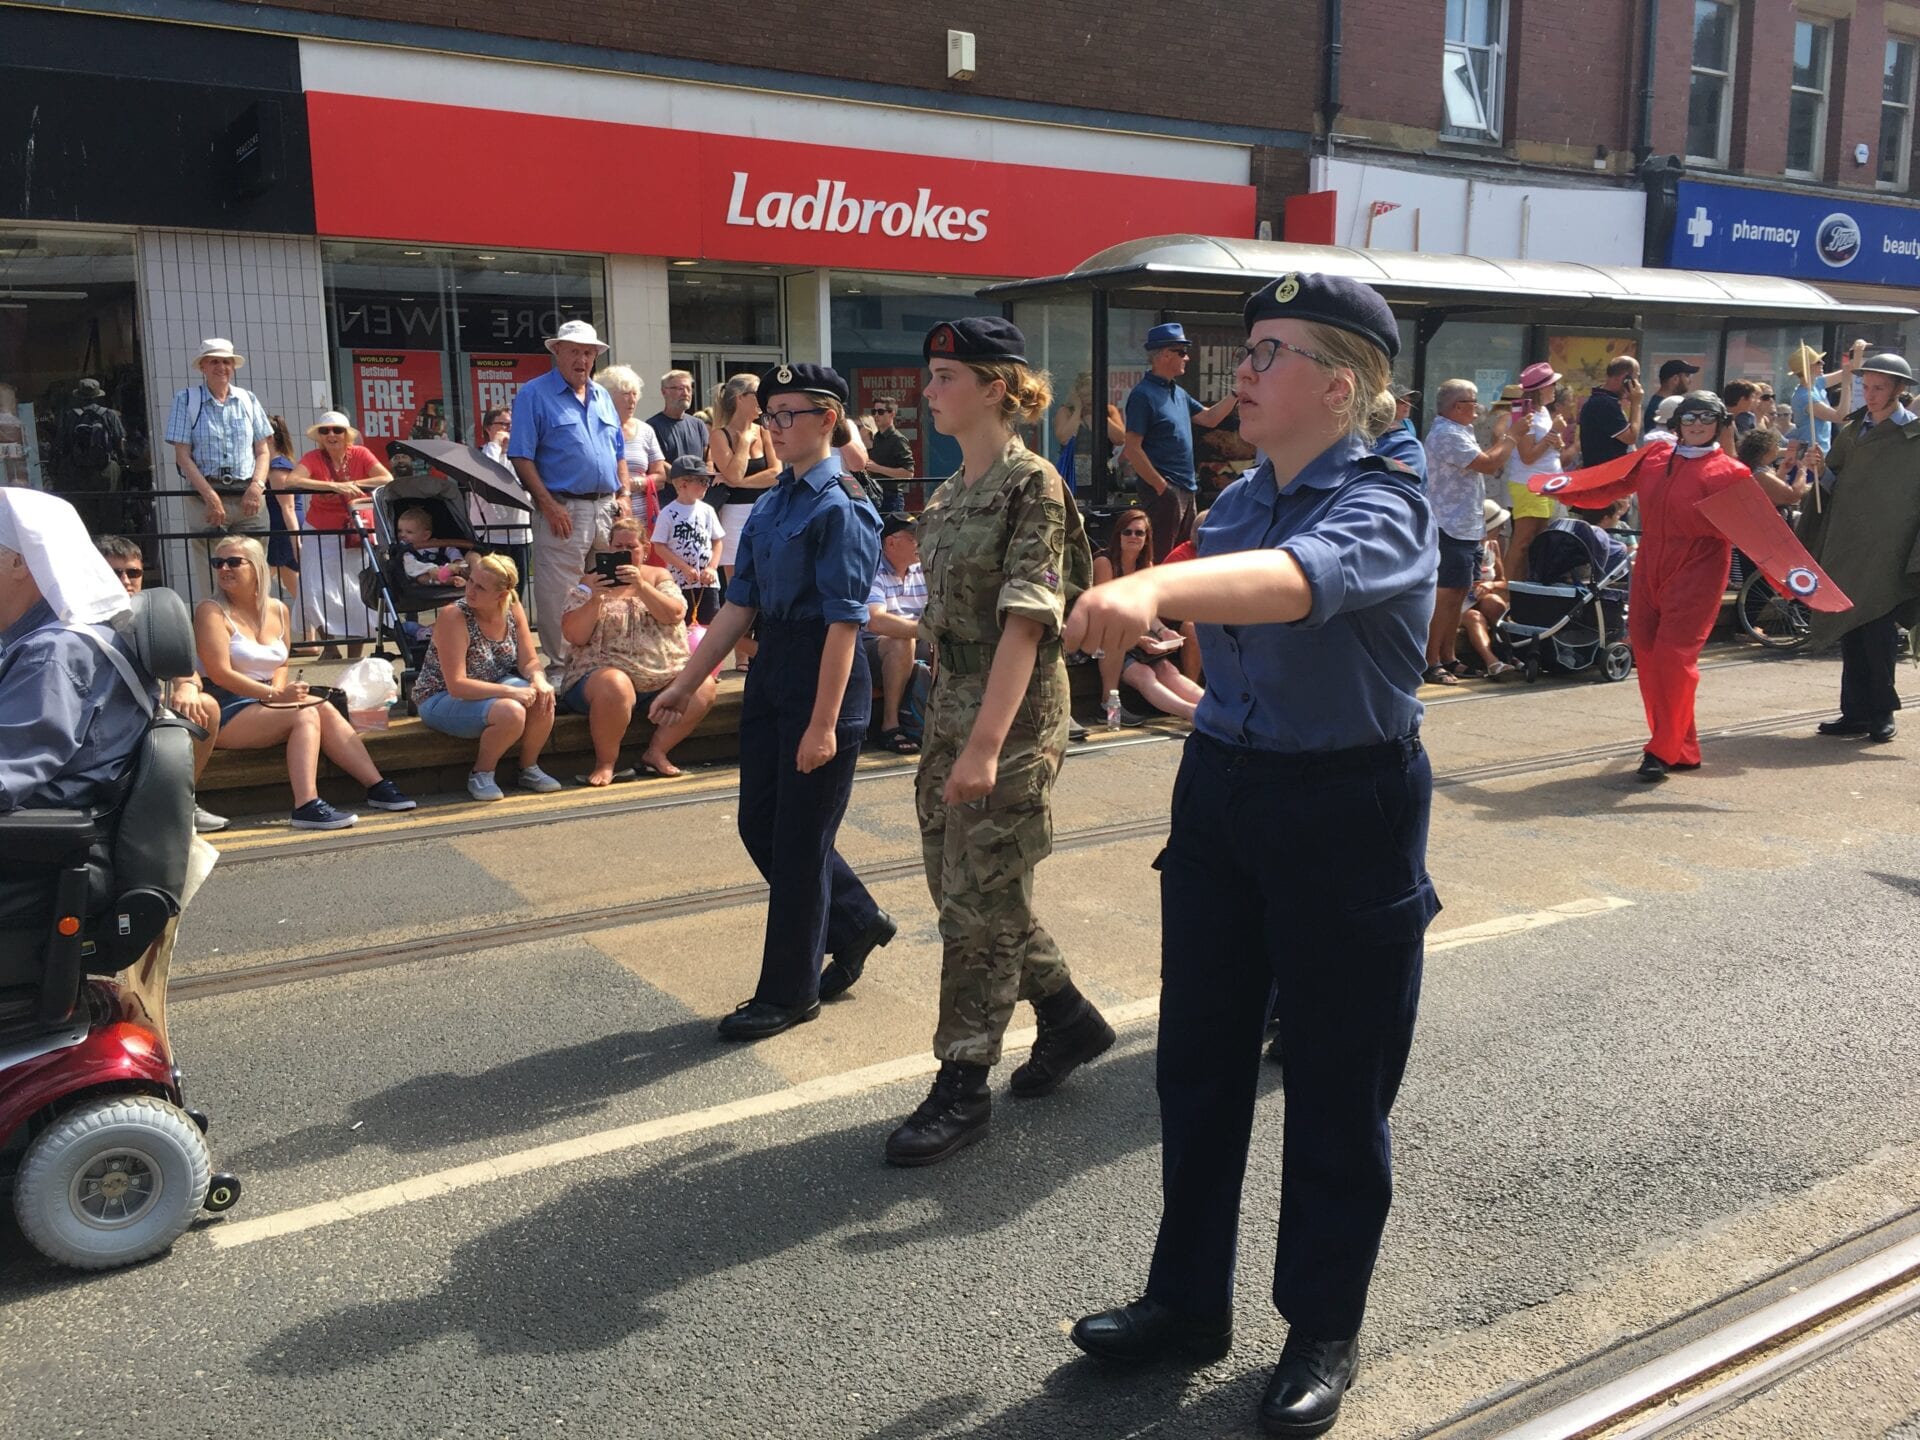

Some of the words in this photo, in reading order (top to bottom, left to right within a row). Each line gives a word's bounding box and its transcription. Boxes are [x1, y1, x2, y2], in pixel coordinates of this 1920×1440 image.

[726, 171, 990, 242] Ladbrokes
[1732, 219, 1800, 248] pharmacy
[361, 366, 398, 378] BetStation
[862, 375, 897, 389] WHAT'S
[898, 375, 917, 389] THE
[362, 379, 416, 410] FREE
[364, 411, 401, 438] BET
